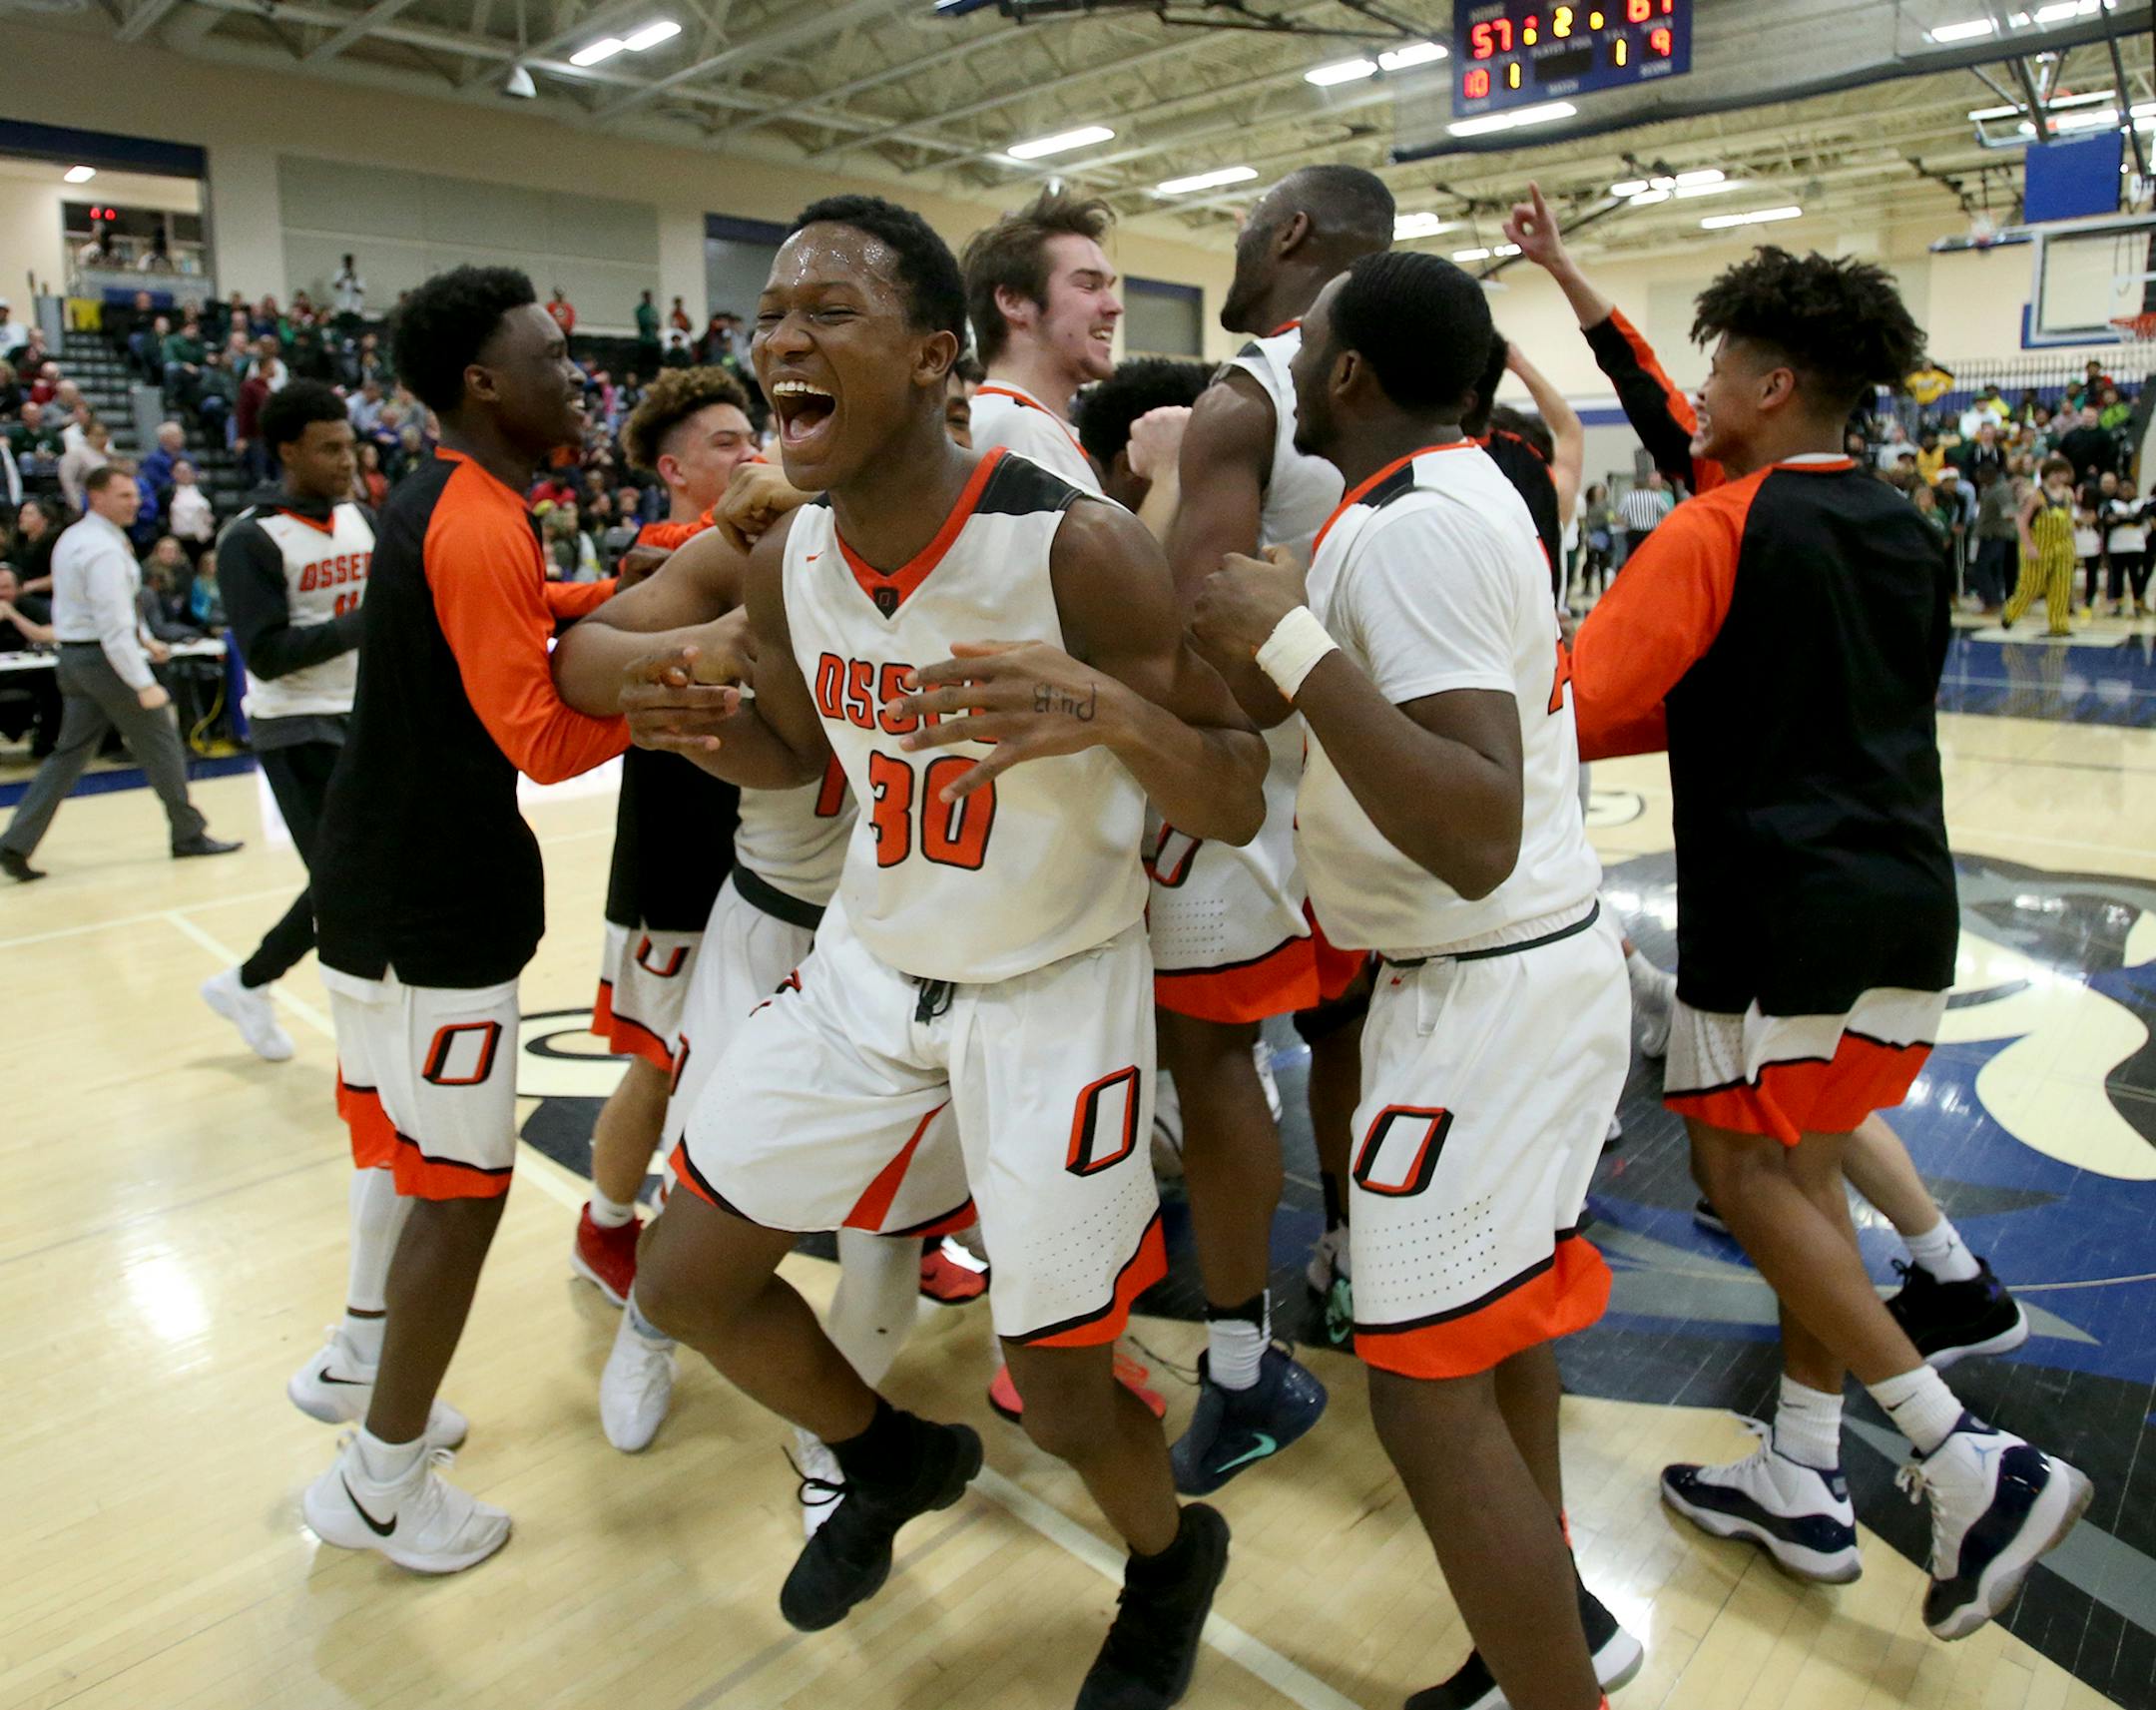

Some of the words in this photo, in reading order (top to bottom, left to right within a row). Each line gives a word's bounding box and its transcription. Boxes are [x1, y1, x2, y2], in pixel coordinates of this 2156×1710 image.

[1471, 18, 1513, 60] 57
[1552, 6, 1574, 38] 2
[1650, 27, 1672, 57] 9
[1615, 38, 1628, 67] 1
[1463, 68, 1490, 99] 10
[1508, 62, 1521, 89] 1
[815, 652, 998, 745] OSS
[868, 750, 997, 870] 30
[422, 1020, 502, 1086] O
[1065, 1065, 1141, 1178] O
[1352, 1103, 1454, 1198] O
